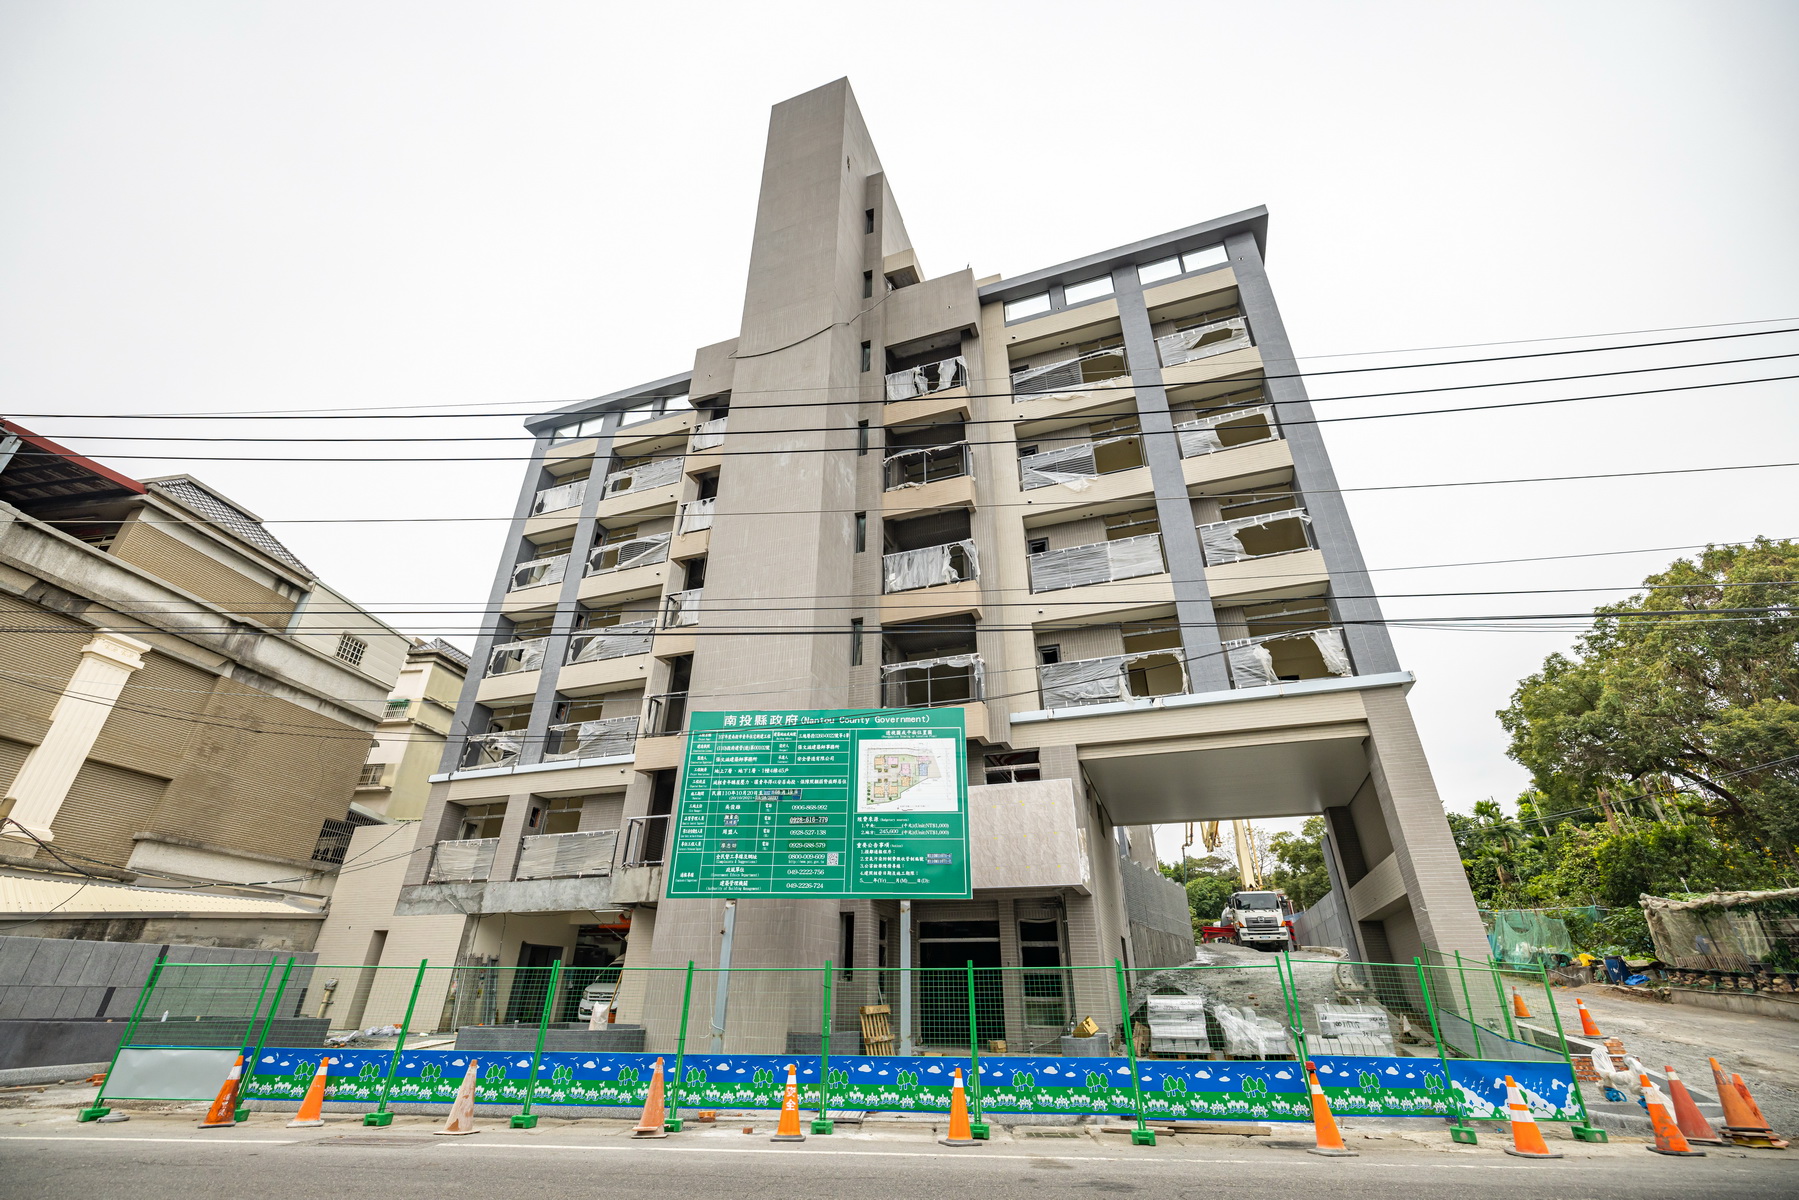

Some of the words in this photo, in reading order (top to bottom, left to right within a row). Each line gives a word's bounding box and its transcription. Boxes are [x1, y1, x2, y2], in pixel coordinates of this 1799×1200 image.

[724, 714, 798, 726] 南投縣政府
[801, 716, 834, 725] (Nantou
[839, 716, 870, 725] County
[874, 714, 930, 724] Government)
[786, 1086, 796, 1111] 安全
